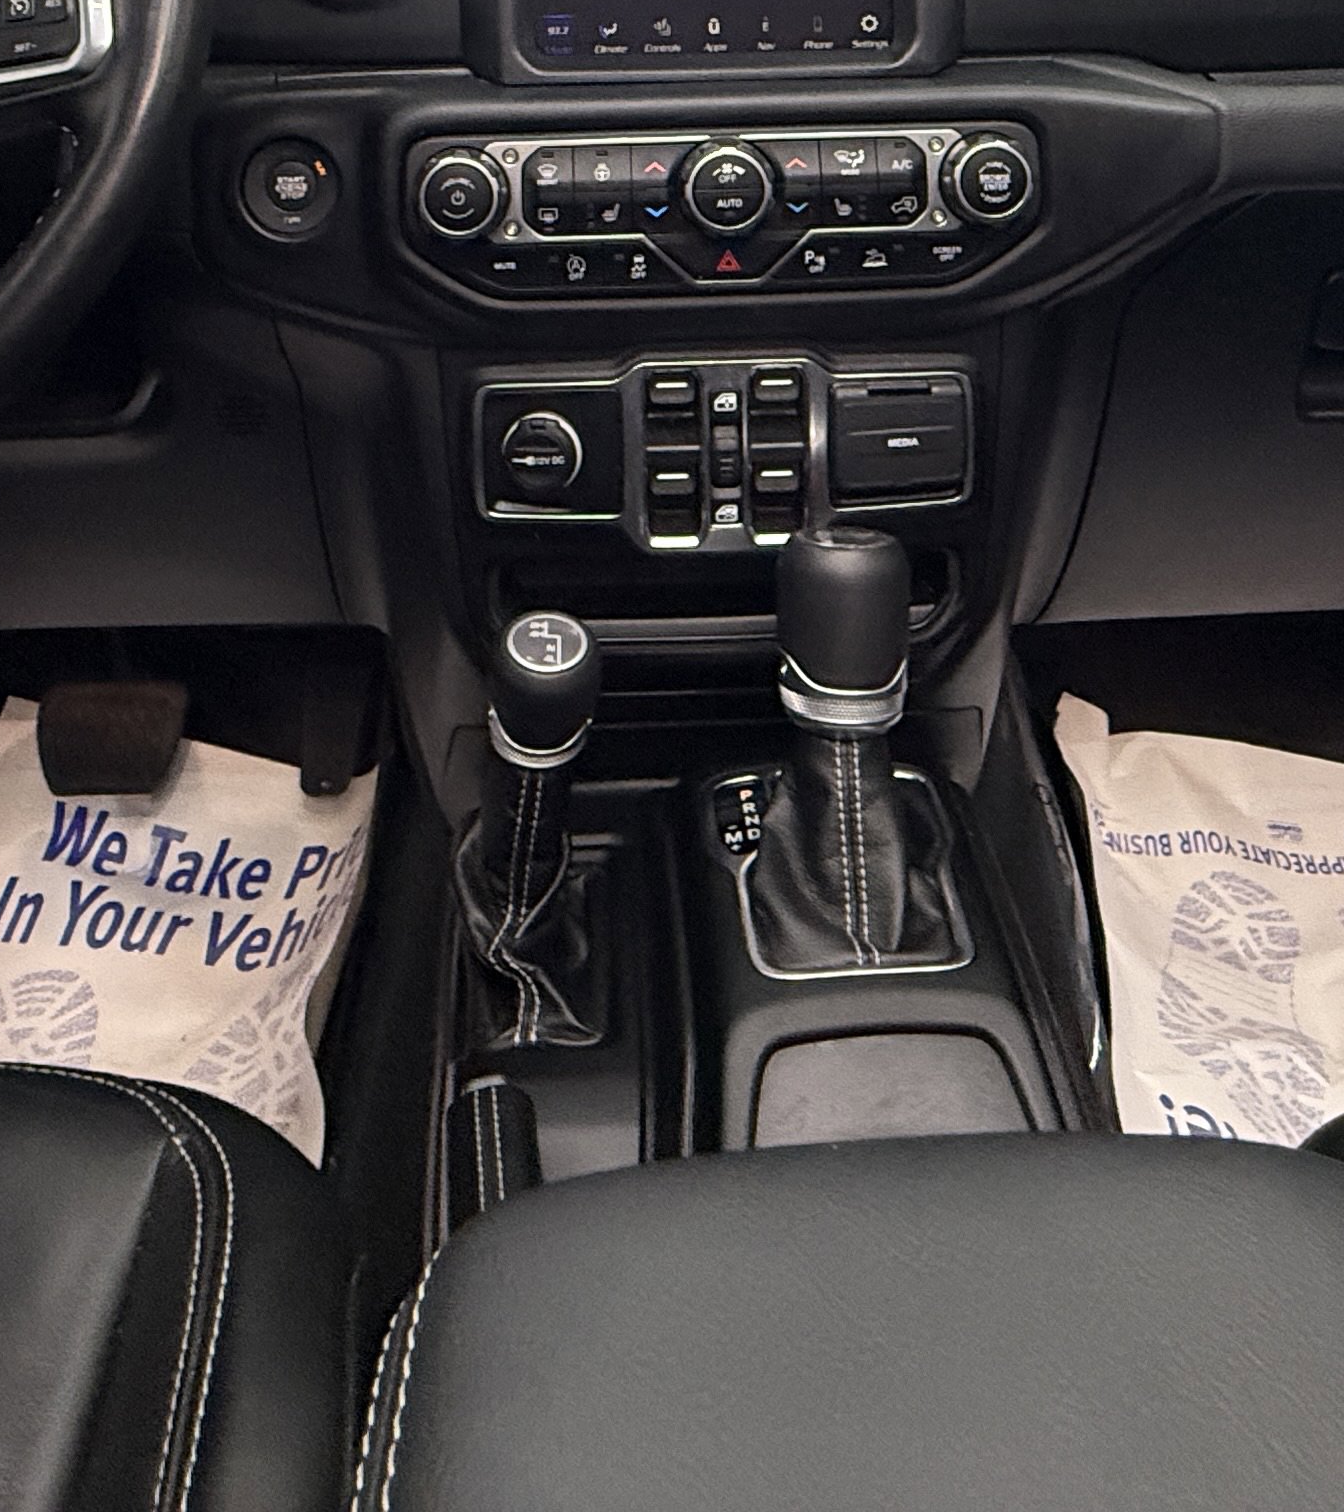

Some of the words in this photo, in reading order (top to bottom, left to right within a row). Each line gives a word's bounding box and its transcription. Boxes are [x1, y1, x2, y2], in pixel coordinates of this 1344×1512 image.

[851, 39, 890, 51] Settings
[891, 159, 914, 171] A/C
[718, 174, 737, 184] OFF
[716, 198, 743, 209] AUTO
[1176, 829, 1238, 857] YOUR
[41, 800, 129, 878] We
[143, 824, 271, 903] Take
[59, 880, 194, 956] Your
